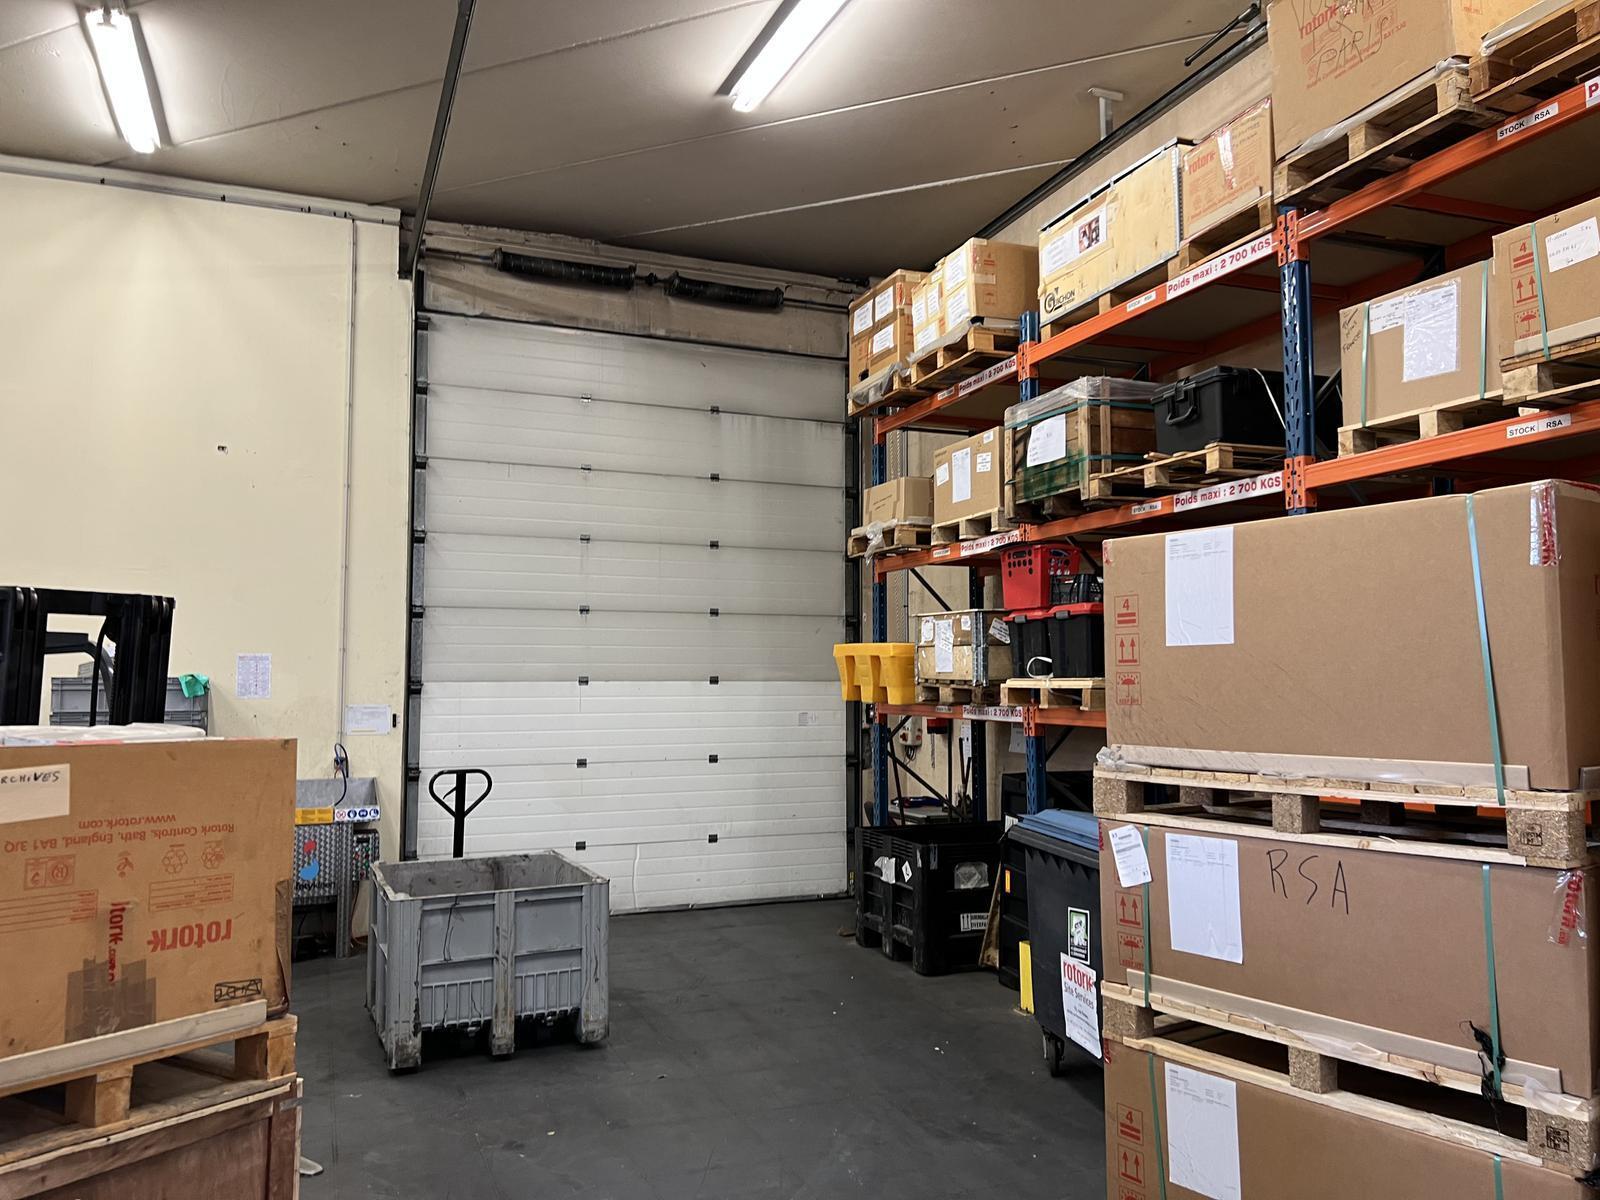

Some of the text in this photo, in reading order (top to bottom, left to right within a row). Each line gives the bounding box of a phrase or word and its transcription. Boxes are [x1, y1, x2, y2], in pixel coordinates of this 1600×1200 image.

[1499, 109, 1551, 137] STOCK RSA
[1520, 242, 1527, 253] 4
[1167, 276, 1190, 294] Poids
[1193, 267, 1213, 281] maxi
[1220, 259, 1226, 269] 2
[1230, 249, 1248, 265] 700
[1250, 238, 1271, 254] KGS
[1508, 418, 1563, 437] STOCK RSA
[1174, 494, 1198, 507] Poids
[1200, 489, 1221, 501] maxi
[1229, 485, 1236, 495] 2
[1238, 480, 1257, 494] 700
[1260, 476, 1281, 489] KGS
[1122, 598, 1130, 611] 4
[78, 814, 176, 829] www.rotork.com
[201, 823, 234, 834] Rotork
[32, 838, 58, 850] BA1
[1267, 848, 1349, 915] RSA
[147, 918, 232, 953] rotork
[1063, 960, 1094, 992] rotork
[1063, 981, 1074, 997] Site
[1125, 1110, 1134, 1124] 4
